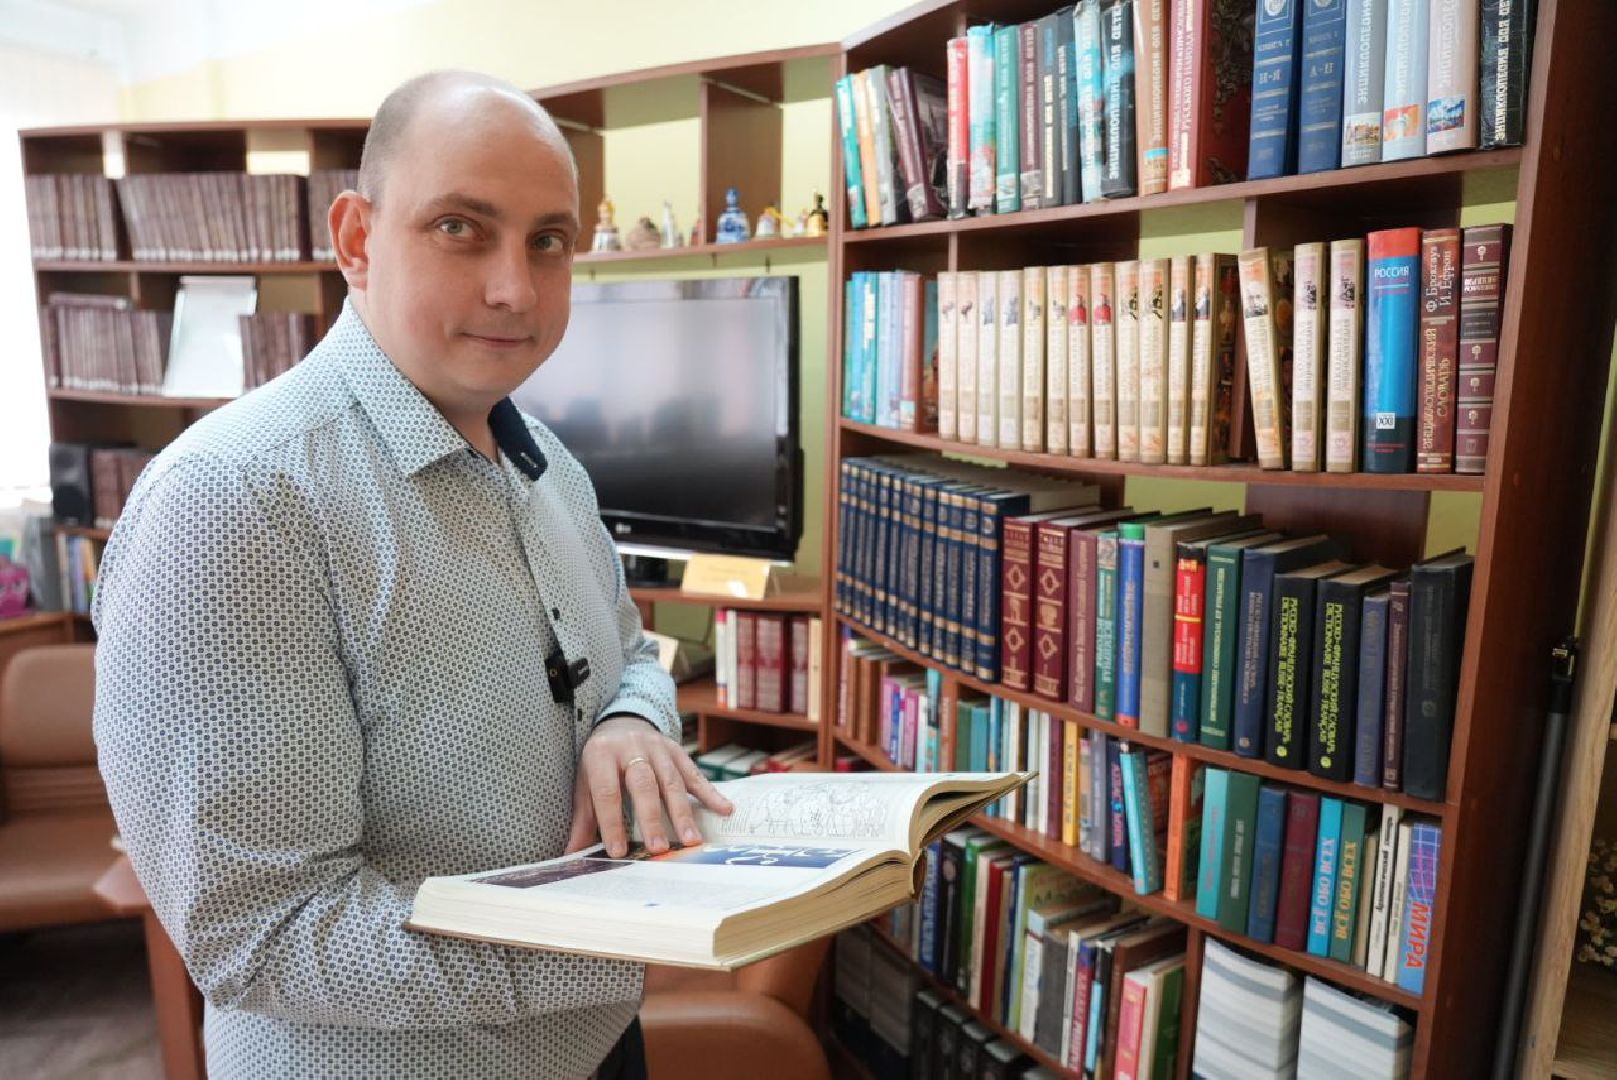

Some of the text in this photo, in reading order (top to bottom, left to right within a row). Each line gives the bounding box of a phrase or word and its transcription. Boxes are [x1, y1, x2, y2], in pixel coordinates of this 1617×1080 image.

[1109, 76, 1121, 180] ЭНЦИКЛОПЕДИЯ
[1374, 265, 1409, 278] РОССИЯ
[1425, 246, 1441, 296] Брокгауз
[1437, 250, 1455, 306] И. Ефрон
[1421, 327, 1437, 450] ЭНЦИКЛОПЕДИЧЕСКИЙ
[1437, 357, 1450, 417] СЛОВАРЬ
[1320, 837, 1335, 875] ВСЕХ
[1341, 840, 1356, 878] ВСЕХ
[1405, 902, 1431, 969] МИРА
